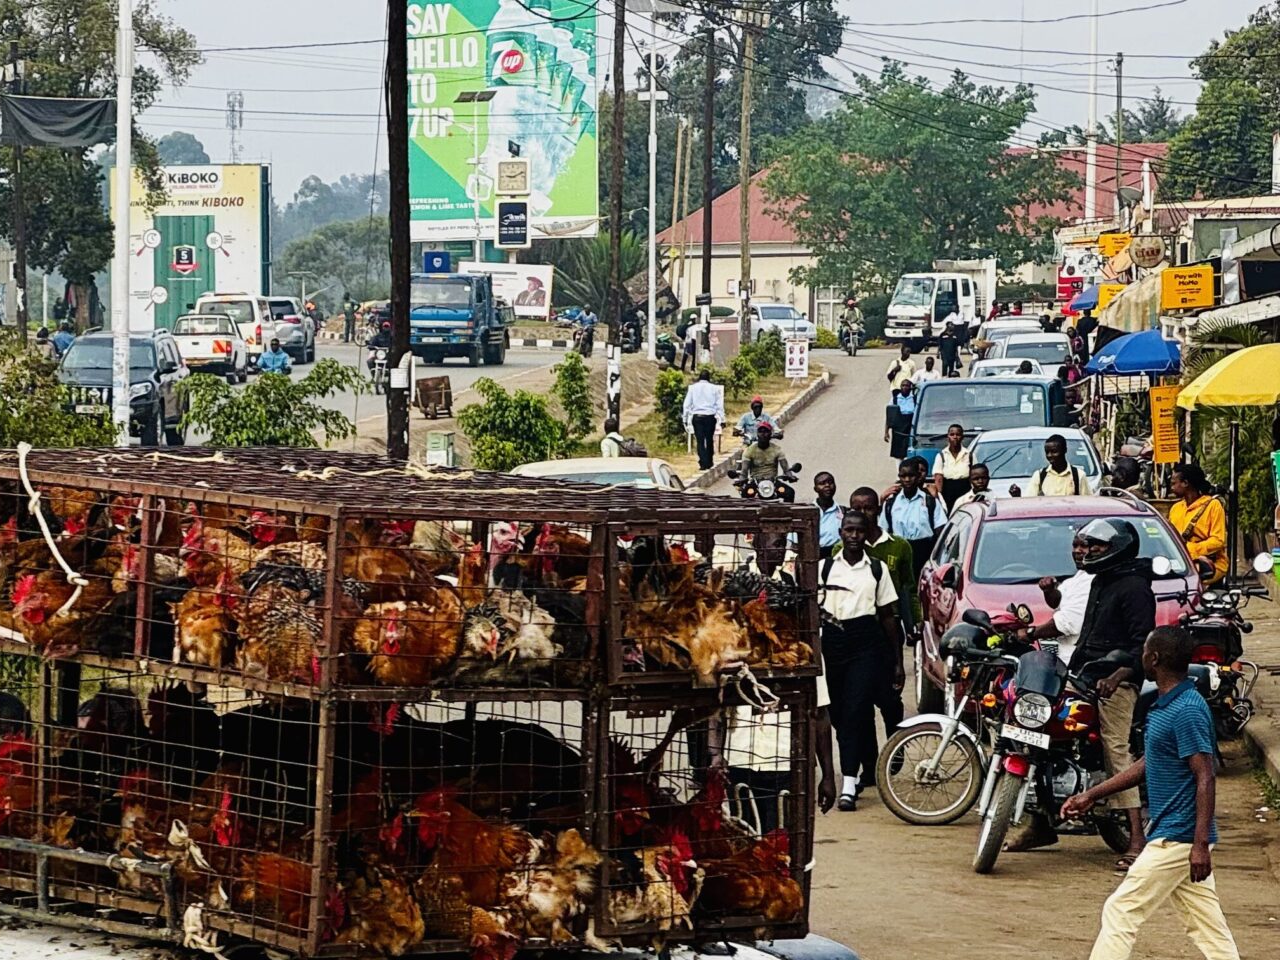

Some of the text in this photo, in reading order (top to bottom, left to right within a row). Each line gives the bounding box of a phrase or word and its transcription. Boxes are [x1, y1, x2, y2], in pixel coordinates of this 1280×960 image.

[408, 4, 451, 36] SAY
[408, 37, 478, 69] HELLO
[408, 73, 437, 104] TO
[409, 107, 454, 138] 7UP
[201, 196, 245, 208] KIBOKO
